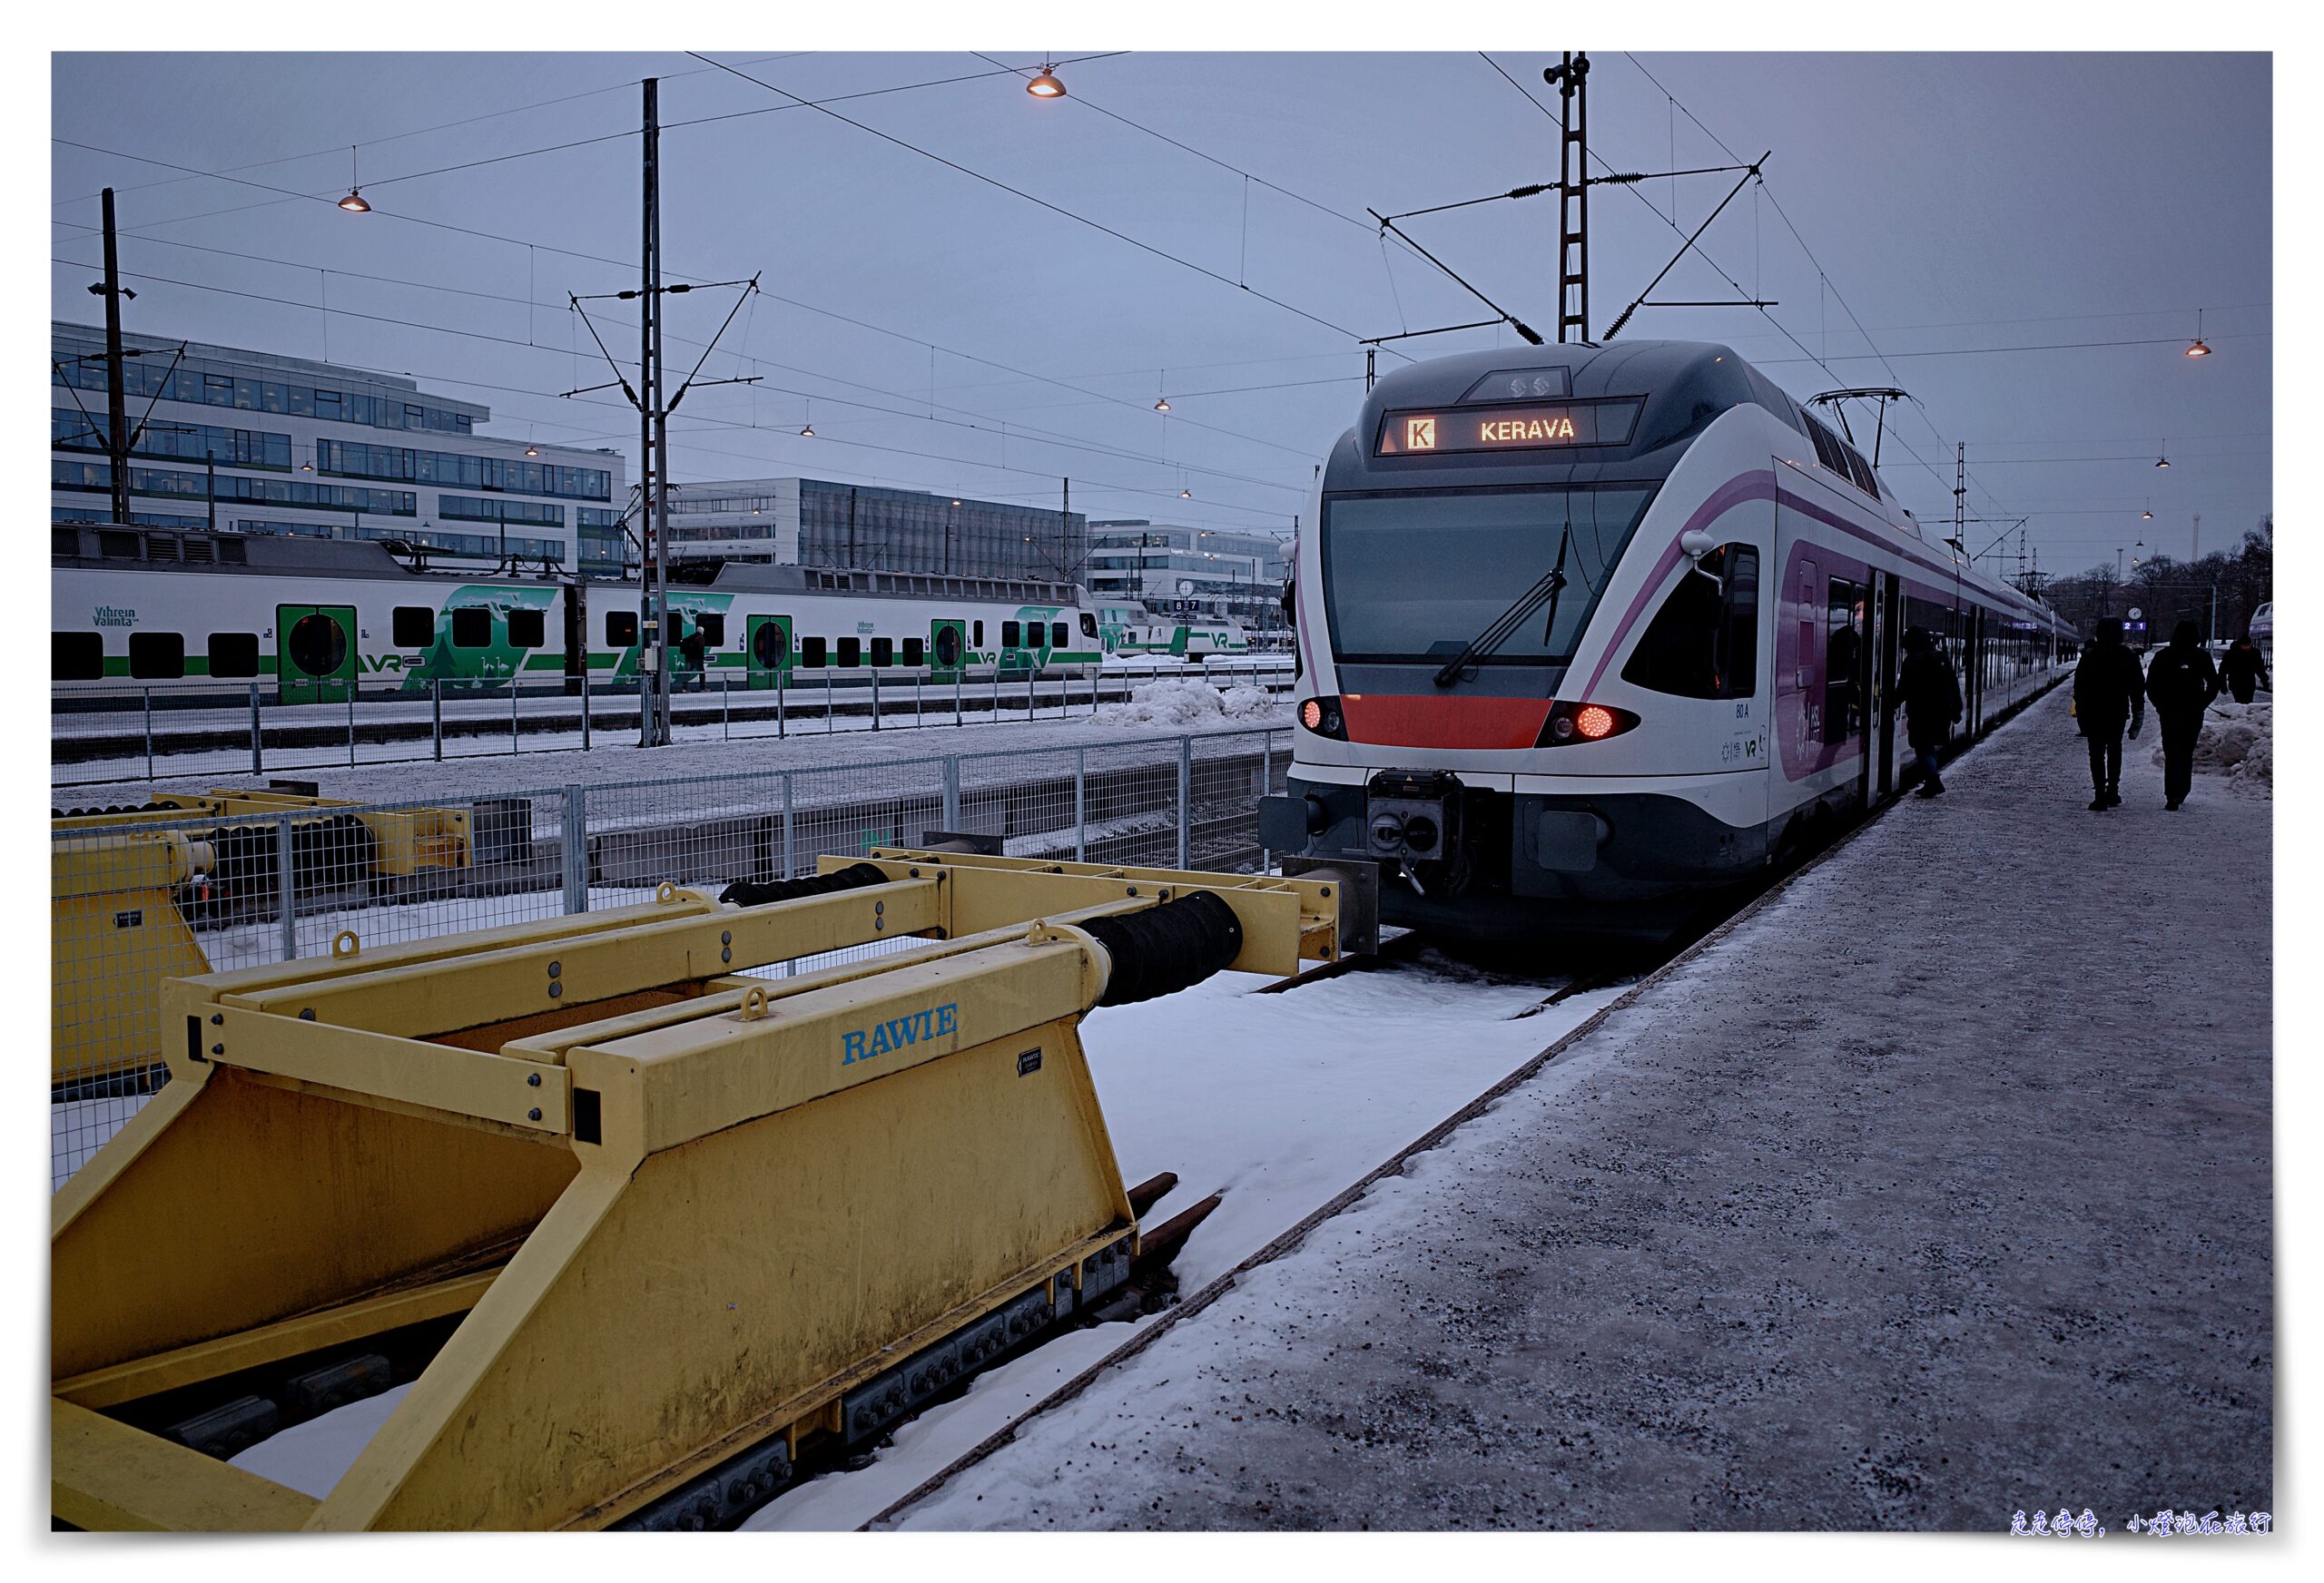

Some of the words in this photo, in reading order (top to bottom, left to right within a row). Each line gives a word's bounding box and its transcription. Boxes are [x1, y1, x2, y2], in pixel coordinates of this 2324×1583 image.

[1413, 422, 1430, 447] K
[1481, 418, 1575, 442] KERAVA
[94, 605, 135, 617] Vihrein
[1176, 601, 1182, 610] 8
[1190, 601, 1196, 610] 7
[93, 615, 133, 626] Valinta
[2124, 622, 2131, 630] 2
[2139, 622, 2143, 630] 1
[1211, 633, 1229, 649] VR
[366, 654, 402, 673] VR
[980, 652, 997, 664] VR
[1736, 703, 1744, 719] 80
[1744, 703, 1749, 718] A
[1745, 740, 1757, 758] VR
[842, 1002, 959, 1067] RAWIE
